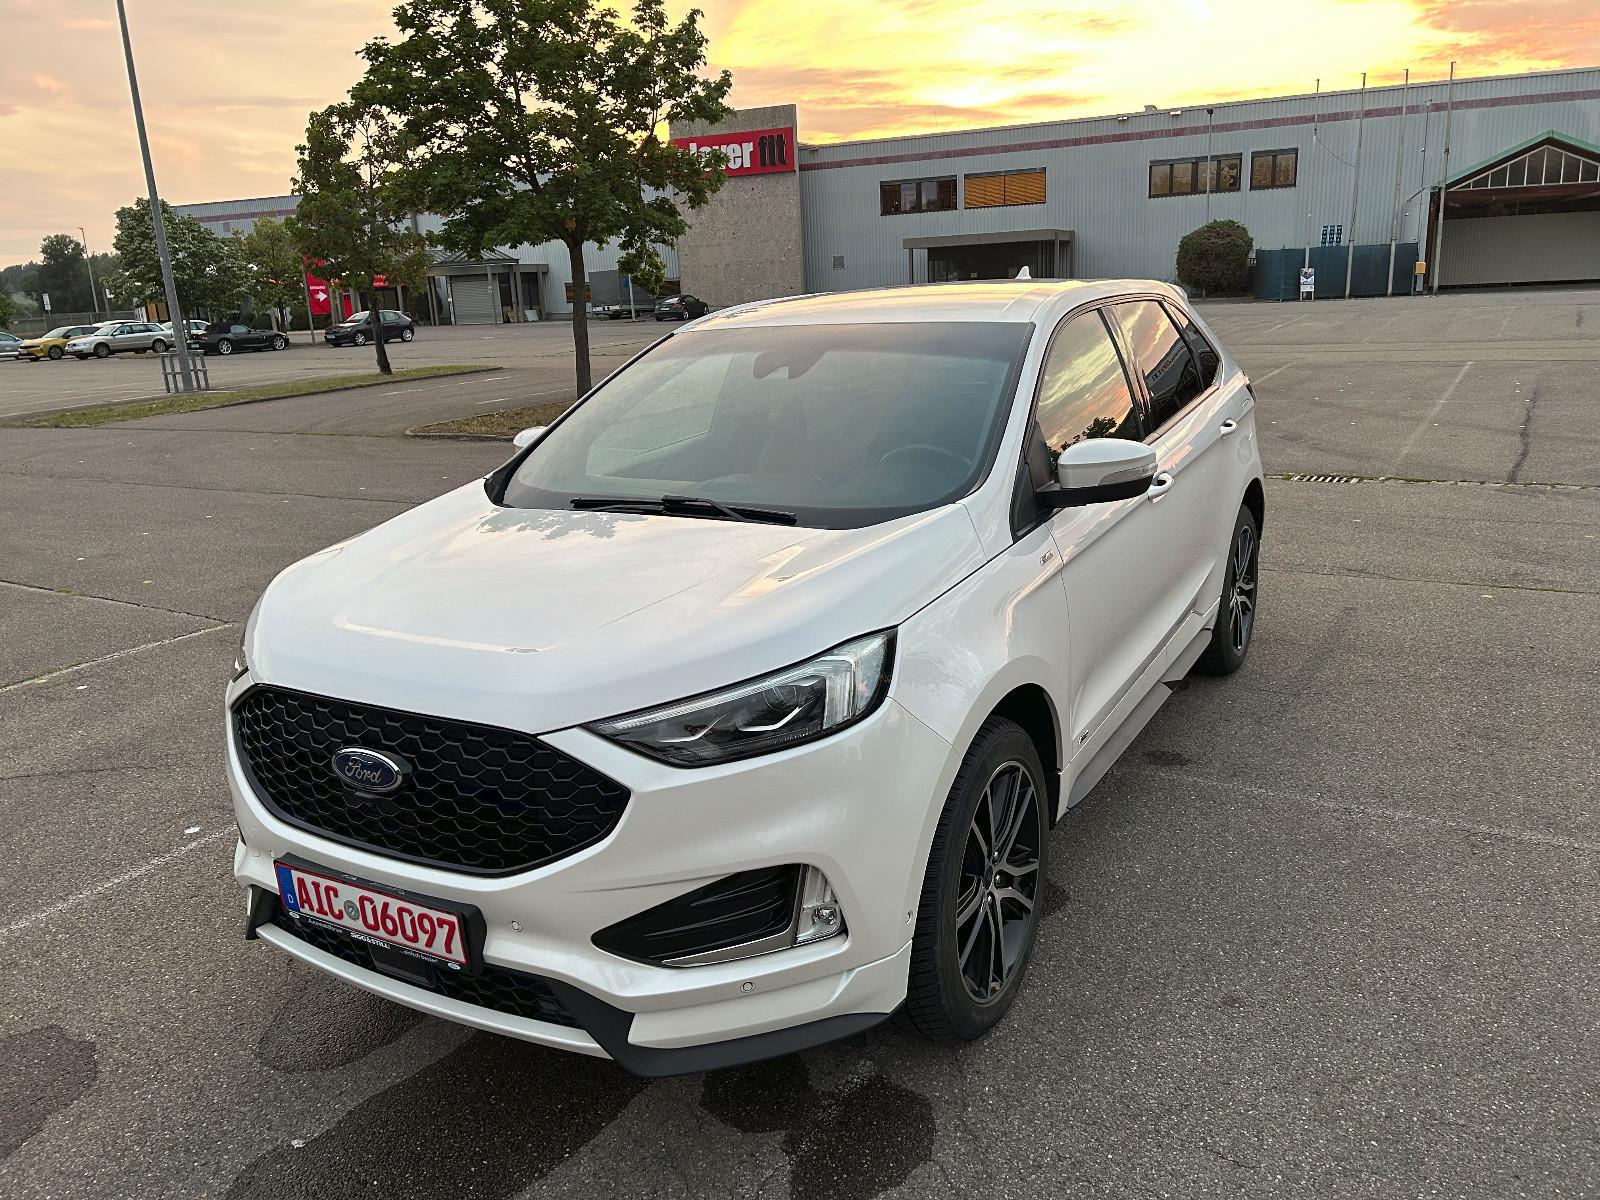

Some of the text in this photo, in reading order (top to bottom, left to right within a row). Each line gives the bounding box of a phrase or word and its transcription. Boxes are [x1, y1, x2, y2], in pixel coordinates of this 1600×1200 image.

[758, 133, 787, 167] fit
[344, 756, 382, 784] Ford
[287, 893, 294, 904] D
[296, 877, 456, 955] AIC 06097
